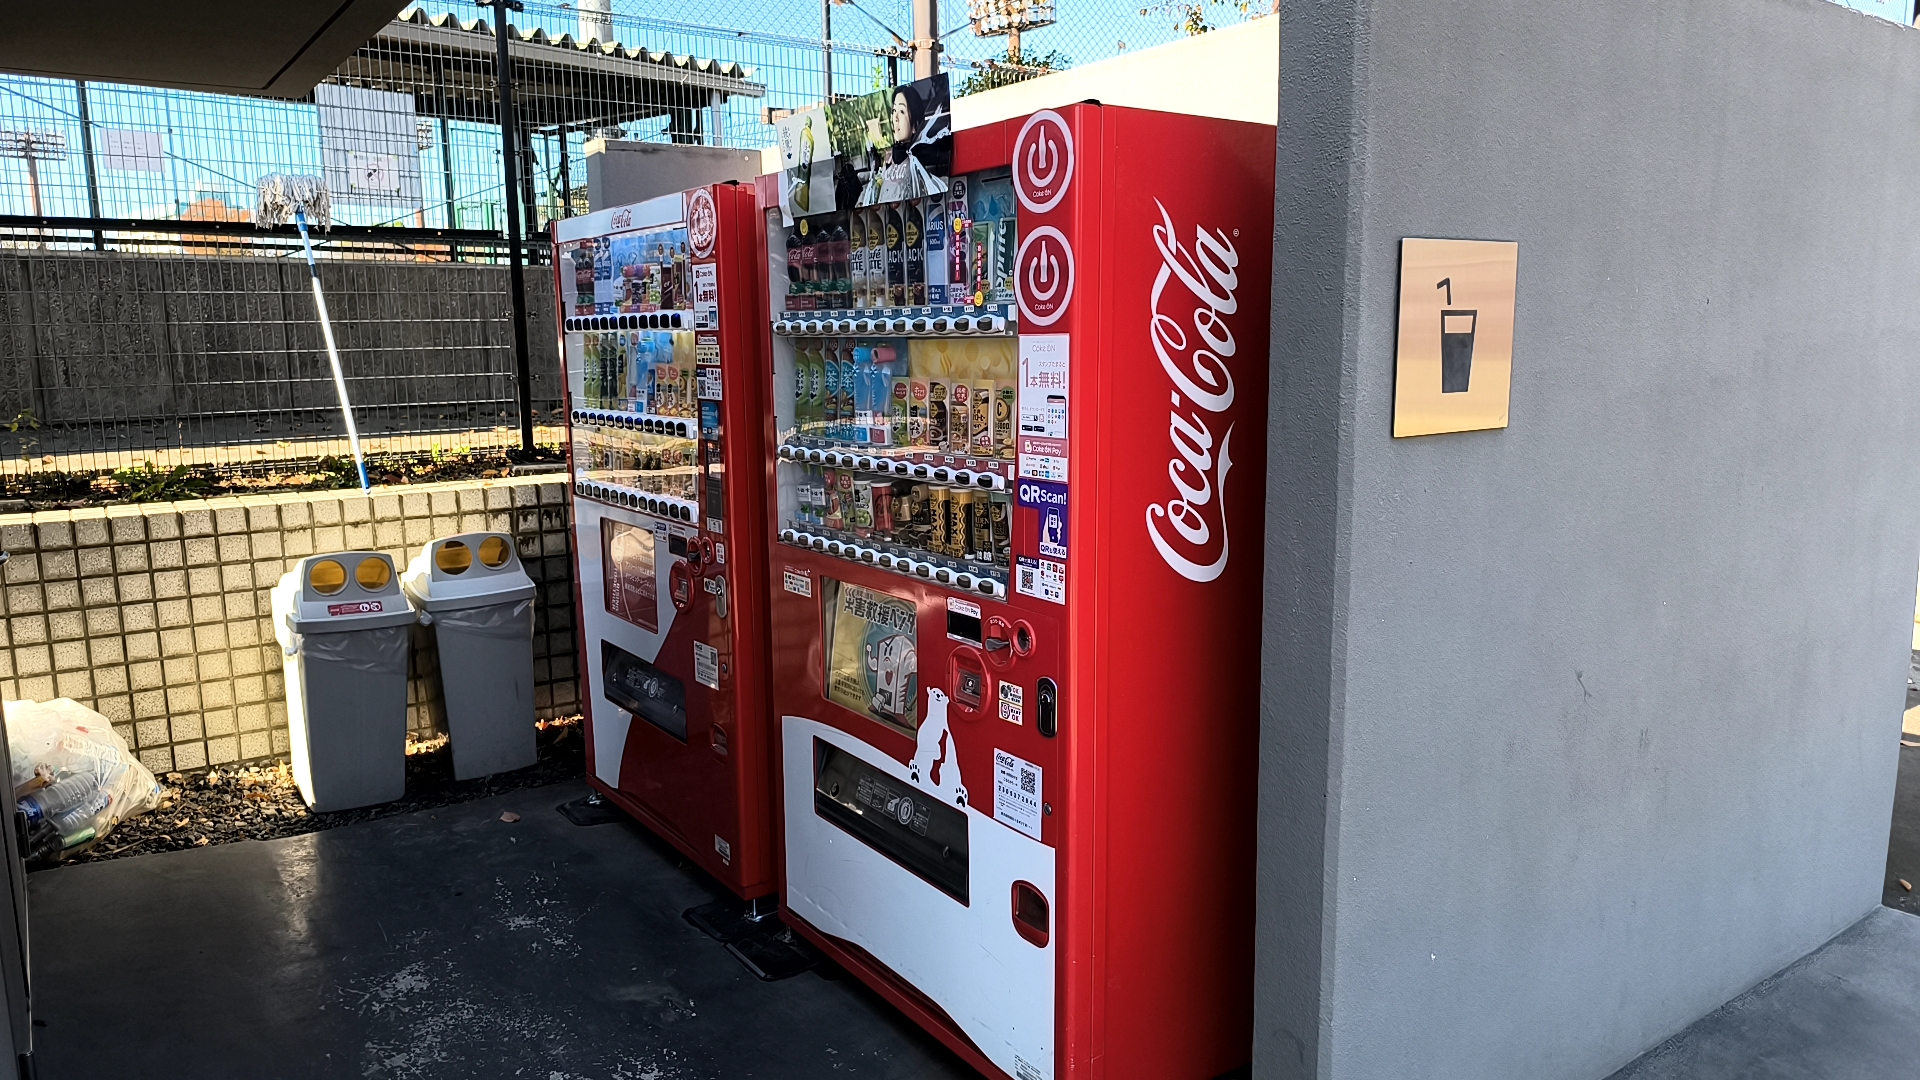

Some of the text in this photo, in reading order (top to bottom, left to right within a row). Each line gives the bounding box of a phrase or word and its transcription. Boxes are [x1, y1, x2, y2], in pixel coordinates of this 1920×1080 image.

[1032, 190, 1044, 198] Coke
[1436, 277, 1451, 305] 1
[1145, 196, 1239, 582] Coca-Cola
[970, 608, 979, 617] Pay
